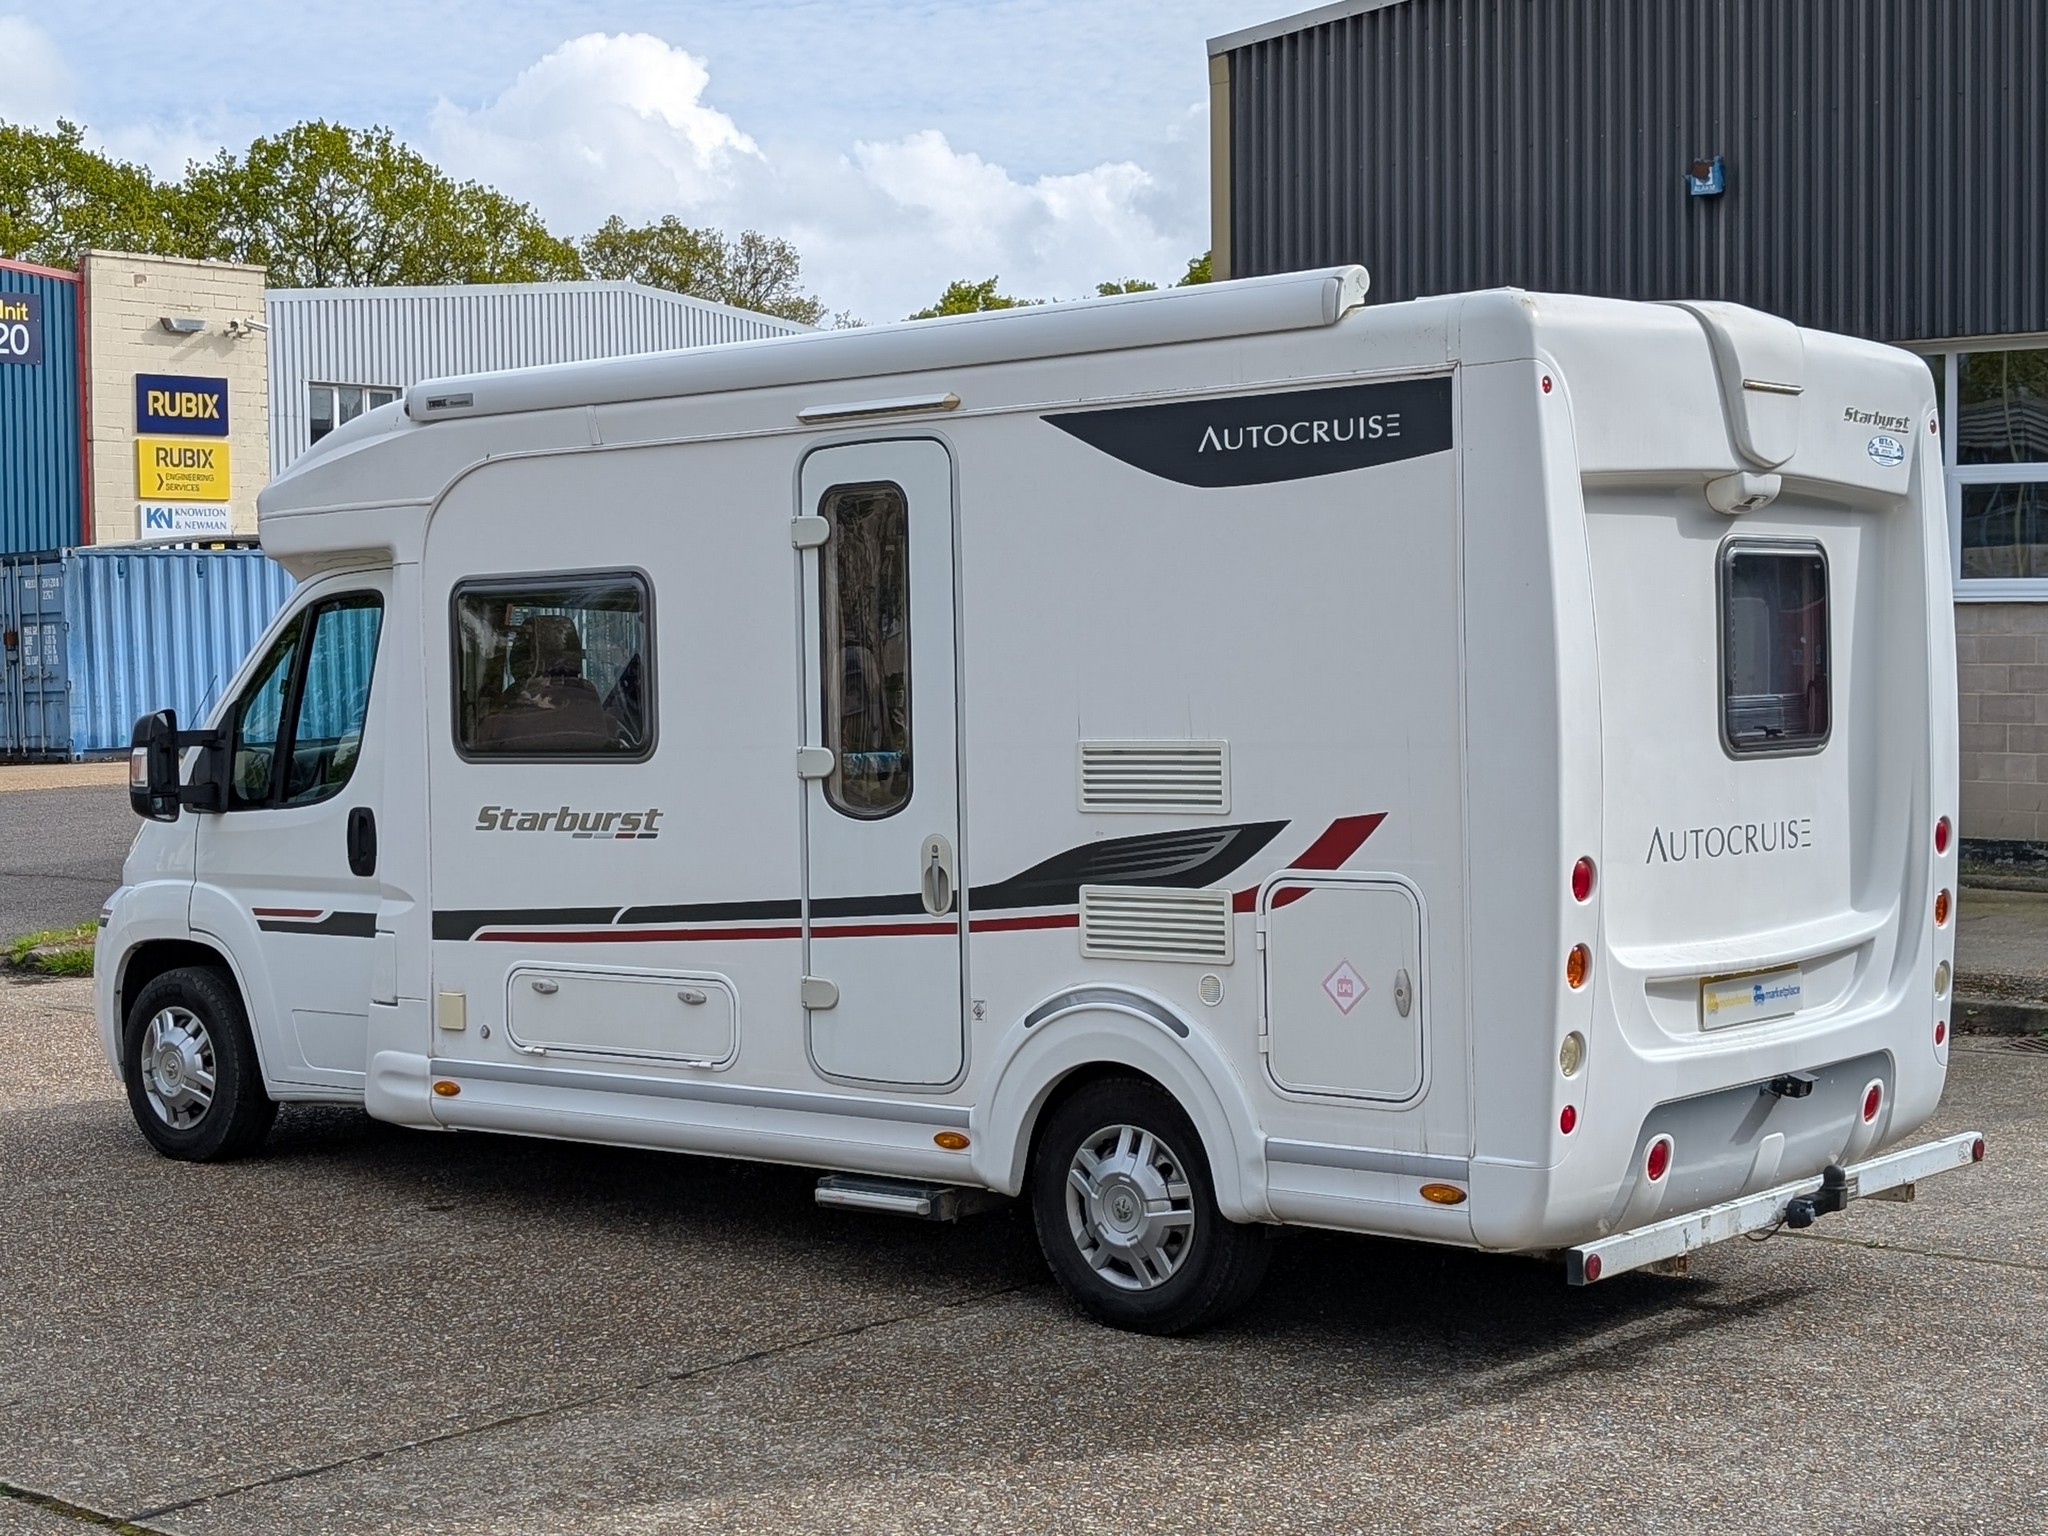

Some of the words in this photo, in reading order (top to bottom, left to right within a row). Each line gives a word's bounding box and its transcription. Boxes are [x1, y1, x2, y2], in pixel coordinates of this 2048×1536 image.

[0, 299, 29, 321] nit
[0, 322, 30, 356] 20
[147, 390, 220, 419] RUBIX
[1843, 407, 1910, 430] Starburst
[1198, 414, 1400, 453] AUTOCRUISE
[155, 447, 214, 469] RUBIX
[165, 473, 215, 482] ENGINEERING
[165, 483, 200, 492] SERVICES
[174, 507, 227, 517] KNOWLTON
[175, 521, 182, 530] &
[184, 521, 227, 530] NEWMAN
[475, 806, 665, 832] Starburst
[1646, 818, 1812, 864] AUTOCRUISE
[1765, 984, 1801, 1000] marketplace
